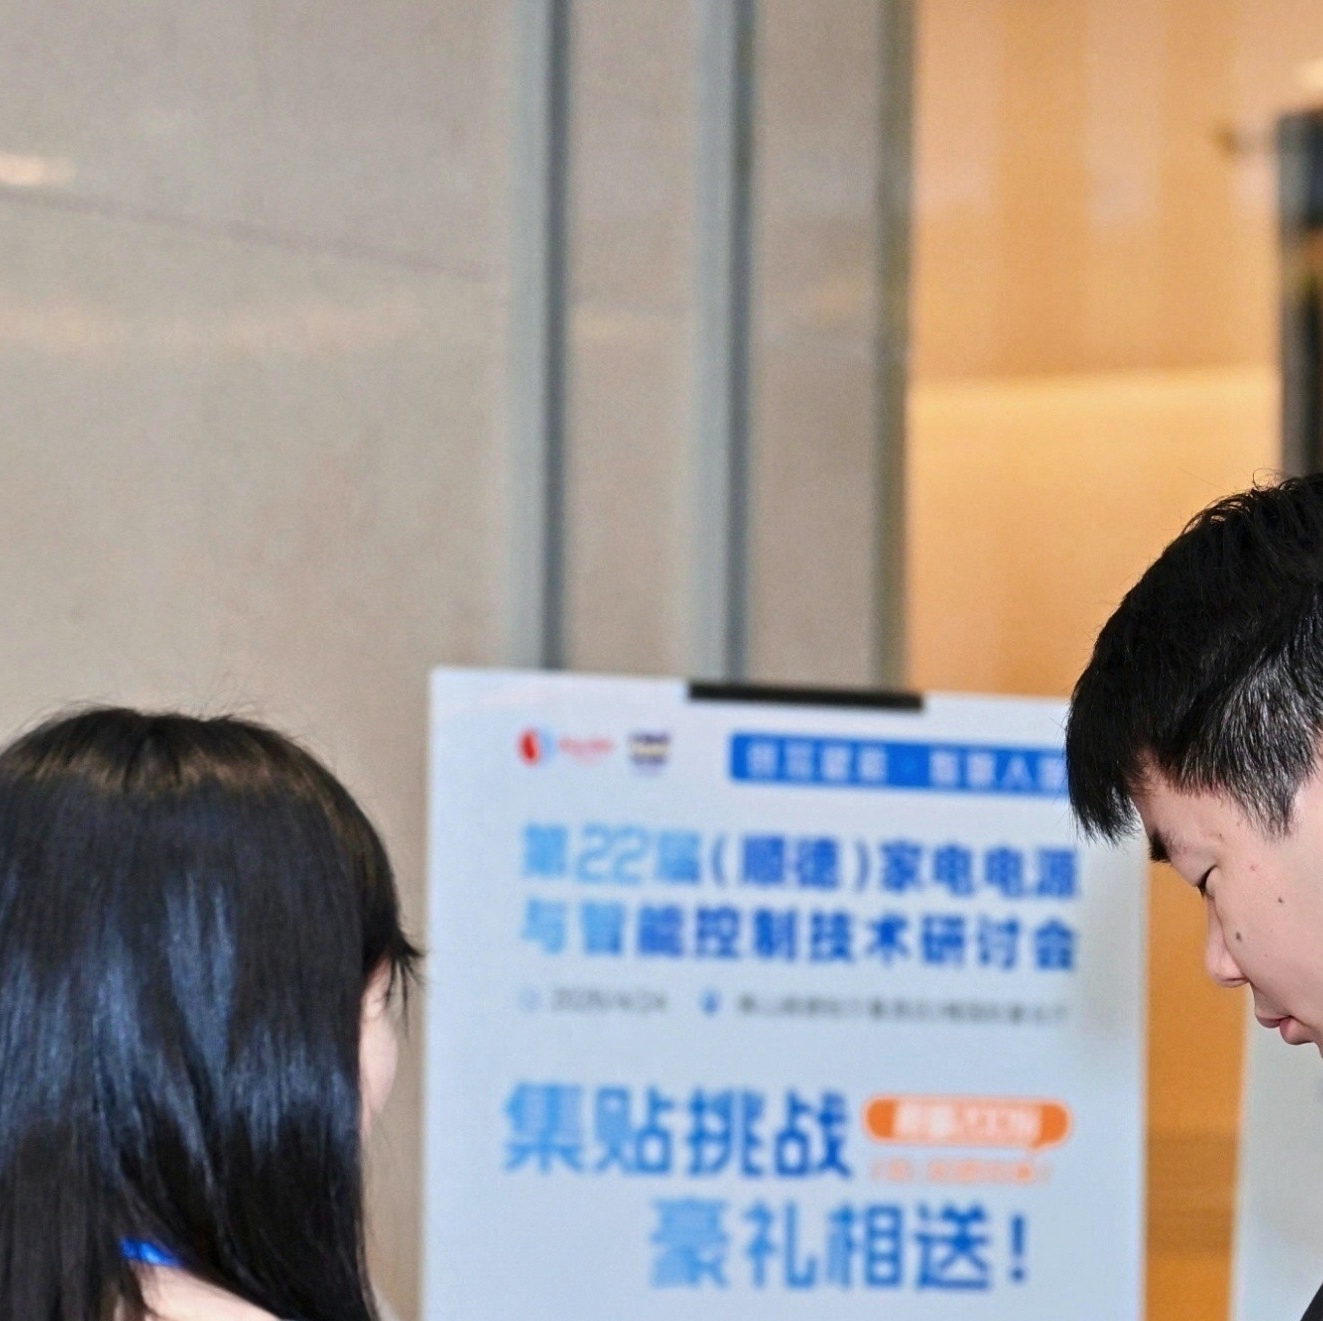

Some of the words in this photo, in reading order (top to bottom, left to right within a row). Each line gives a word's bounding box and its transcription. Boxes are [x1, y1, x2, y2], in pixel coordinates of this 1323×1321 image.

[521, 896, 1078, 972] 与智能控制技术研讨会
[501, 1080, 854, 1181] 集贴挑战
